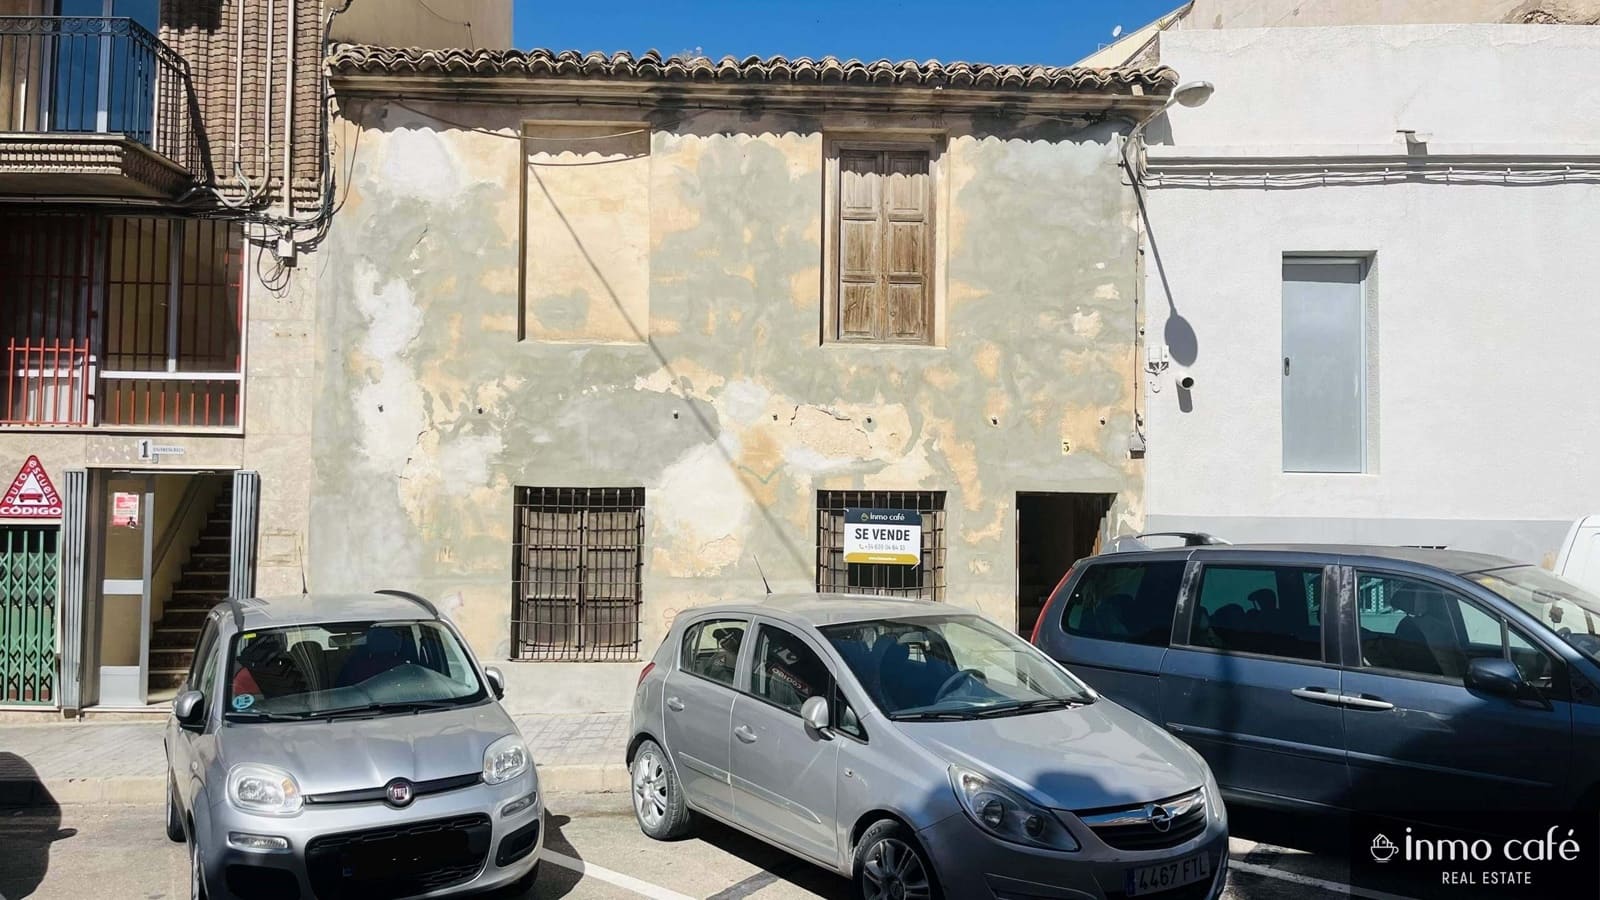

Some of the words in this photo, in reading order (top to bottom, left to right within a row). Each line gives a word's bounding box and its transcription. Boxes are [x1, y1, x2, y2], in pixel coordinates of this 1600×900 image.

[142, 441, 149, 458] 1
[0, 505, 62, 515] CÓDIGO
[855, 528, 869, 540] SE
[872, 528, 910, 541] VENDE
[1139, 863, 1178, 889] 4467
[1183, 856, 1206, 880] FTL
